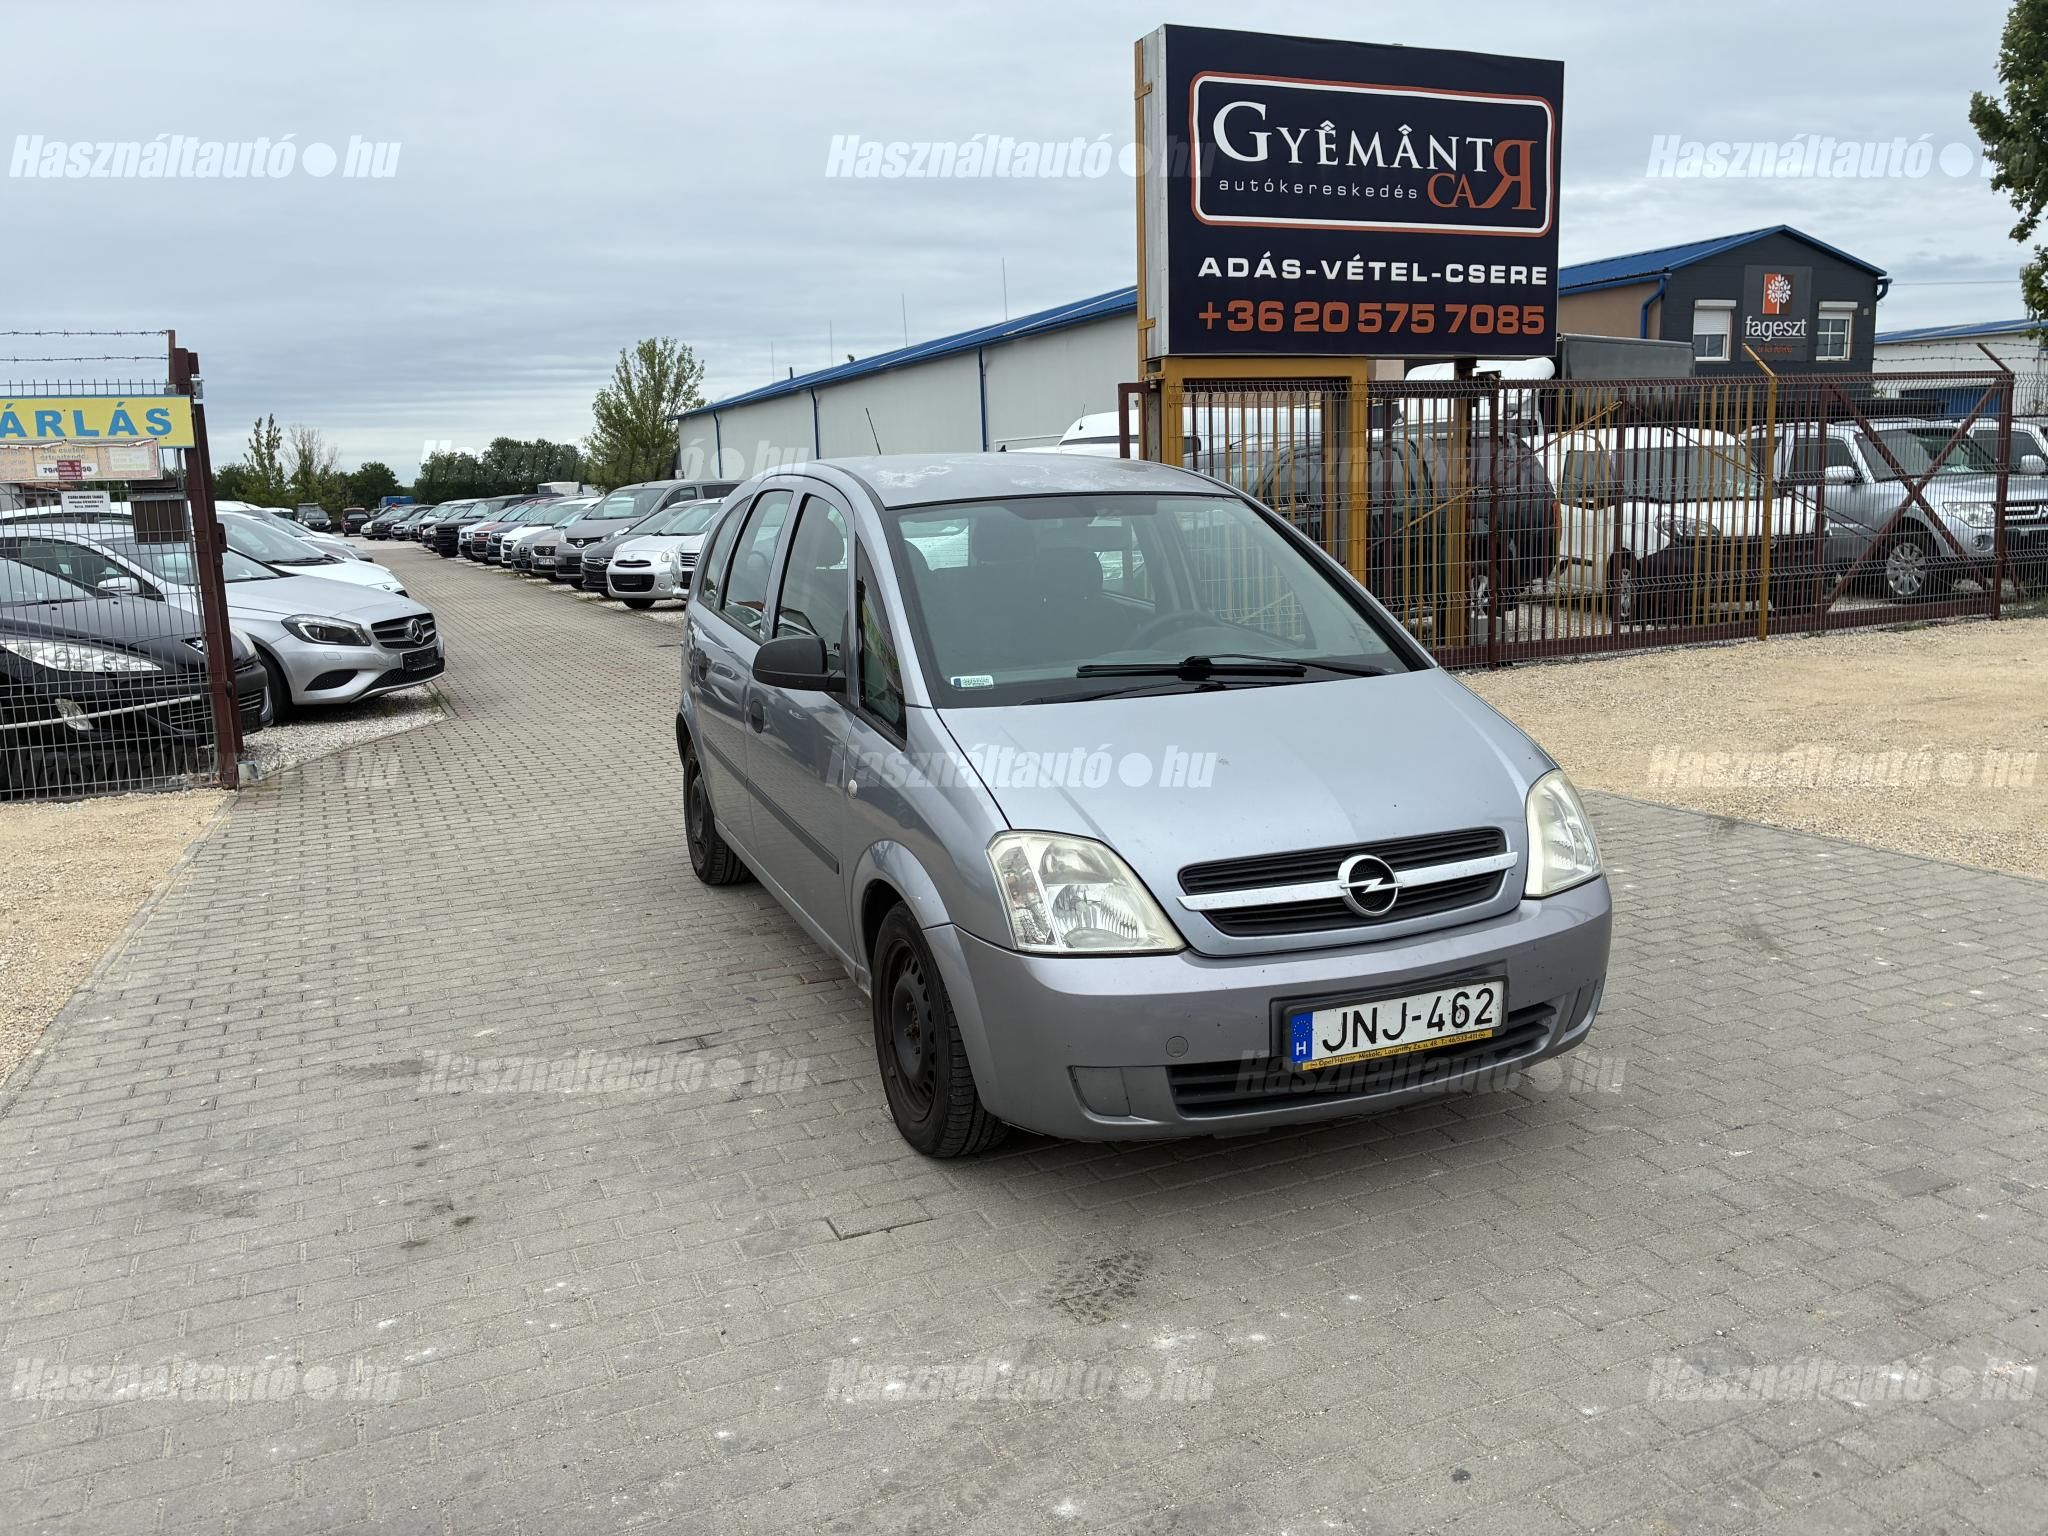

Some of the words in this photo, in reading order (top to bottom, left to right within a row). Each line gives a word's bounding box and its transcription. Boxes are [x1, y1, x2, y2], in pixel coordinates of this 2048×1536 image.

[1218, 178, 1418, 199] autókereskedés
[1198, 300, 1285, 333] +36
[1294, 301, 1350, 333] 20
[1357, 303, 1435, 334] 575
[1445, 304, 1545, 335] 7085
[1745, 316, 1807, 342] fageszt
[1322, 987, 1494, 1052] JNJ-462
[1296, 1041, 1307, 1055] H
